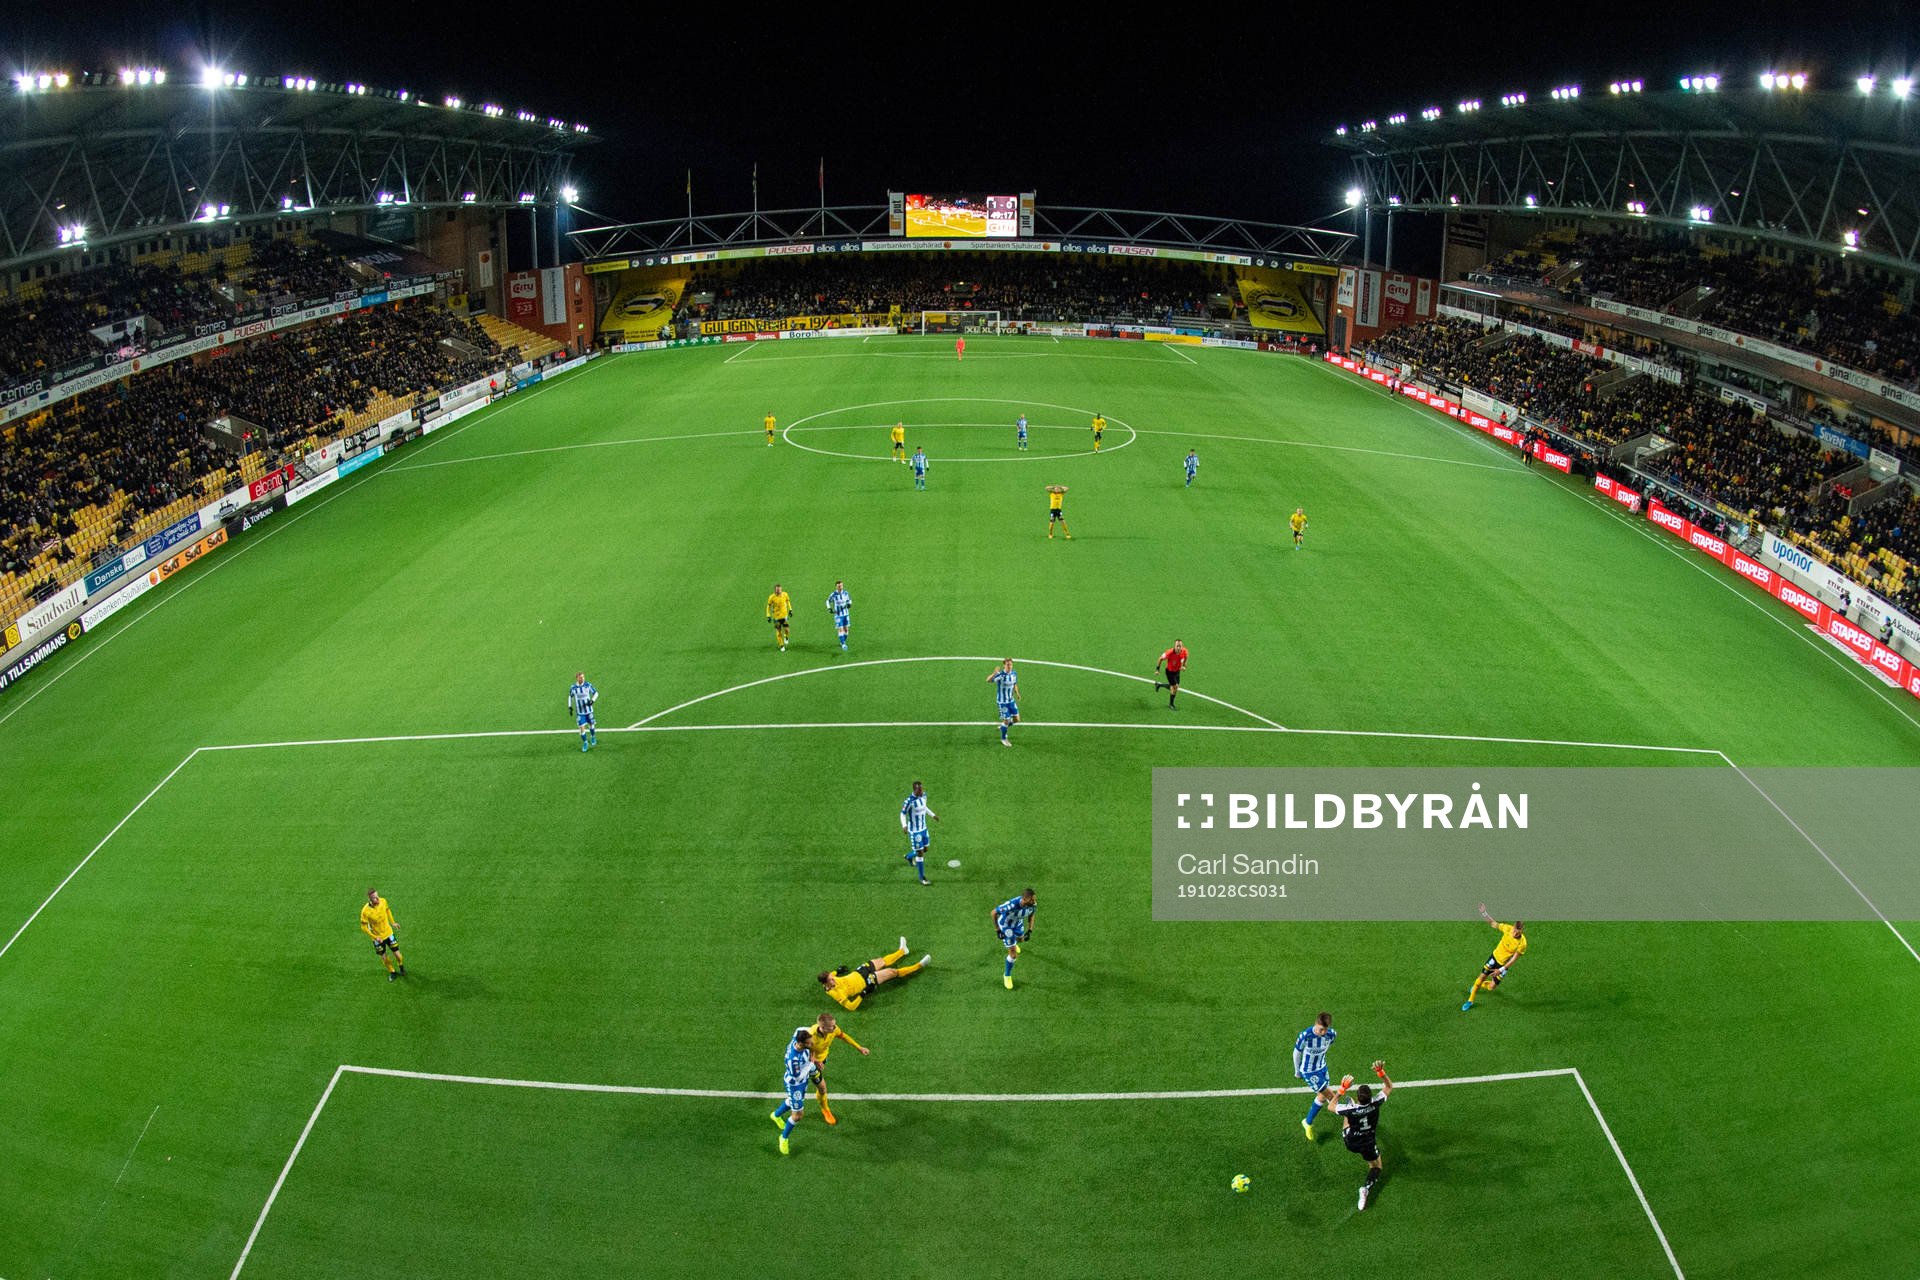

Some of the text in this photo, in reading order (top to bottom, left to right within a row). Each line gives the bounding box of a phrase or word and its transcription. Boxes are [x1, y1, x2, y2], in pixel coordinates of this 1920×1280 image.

[768, 246, 811, 255] PULSEN
[816, 243, 836, 253] ellos
[840, 242, 860, 252] ellos
[871, 241, 911, 250] Sparbanken
[970, 241, 1011, 250] Sparbanken
[1063, 243, 1082, 253] ellos
[1086, 244, 1106, 254] ellos
[1111, 246, 1155, 256] PULSEN
[60, 374, 102, 397] Sparbanken
[1545, 452, 1568, 467] STAPLES
[1652, 509, 1682, 531] STAPLES
[1691, 531, 1725, 556] STAPLES
[1772, 538, 1814, 573] uponor
[94, 550, 145, 587] Danske Bank
[1734, 557, 1770, 584] STAPLES
[26, 587, 81, 635] Sandwall
[84, 594, 123, 627] Sparbanken
[1780, 586, 1819, 615] STAPLES
[1830, 620, 1873, 652] STAPLES
[8, 632, 67, 681] TILLSAMMANS
[1872, 646, 1901, 672] PLES
